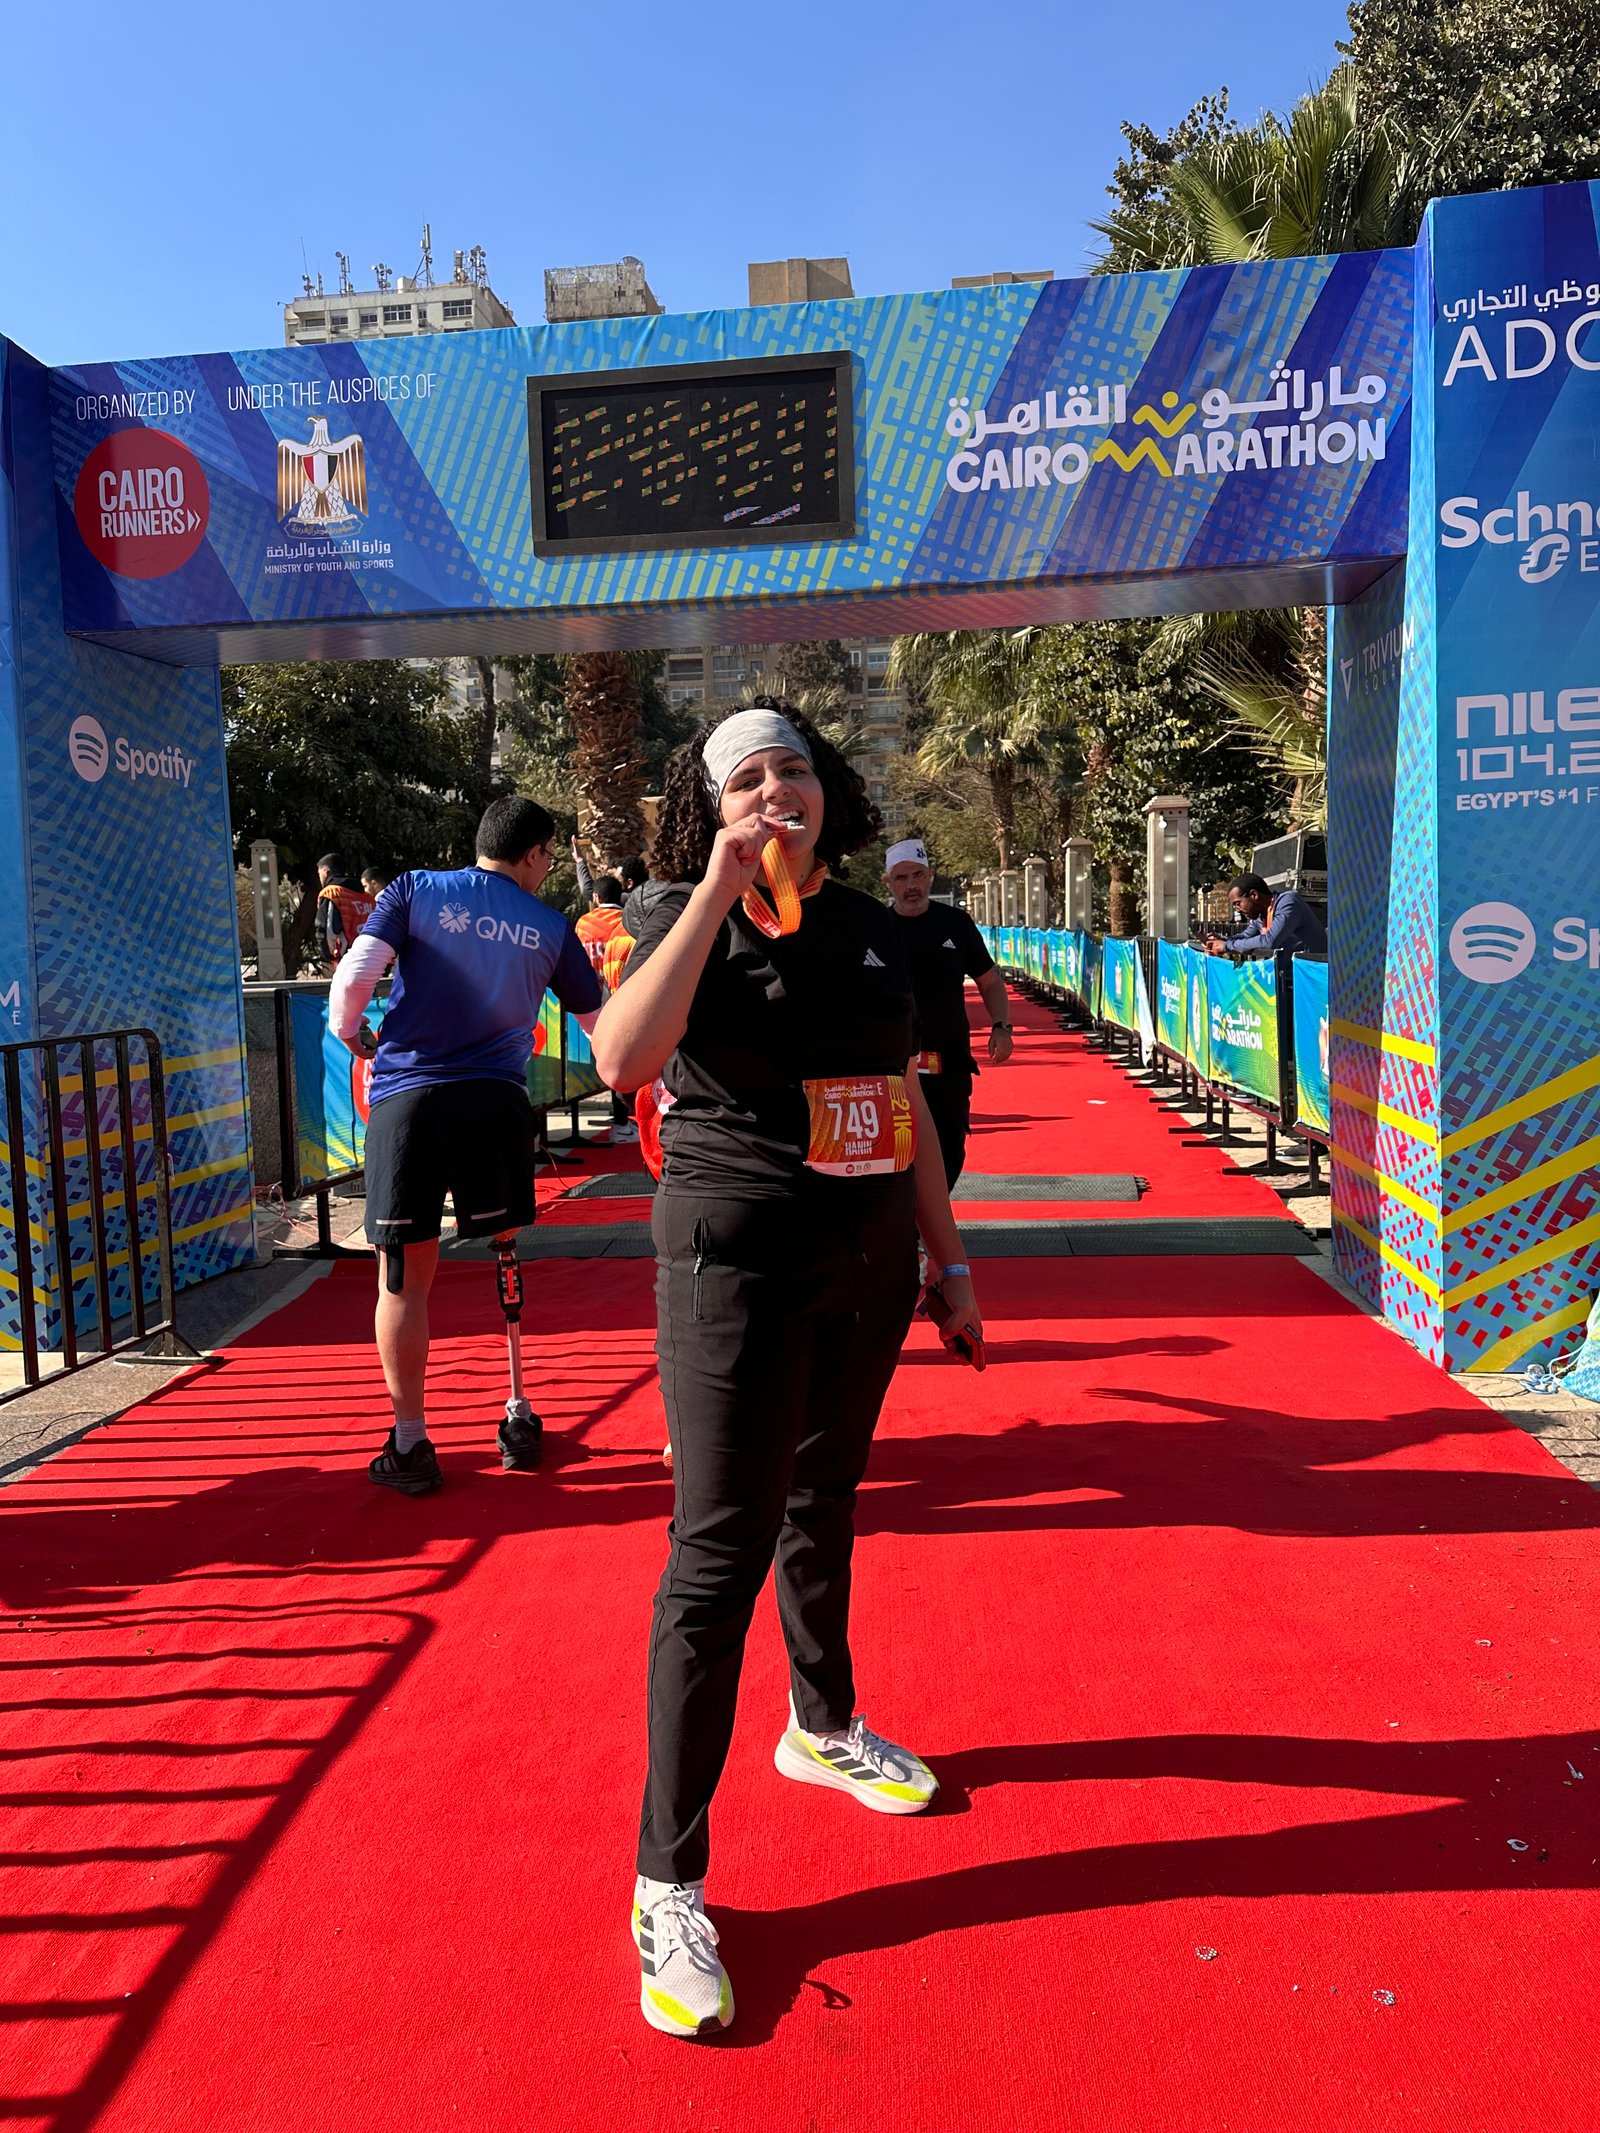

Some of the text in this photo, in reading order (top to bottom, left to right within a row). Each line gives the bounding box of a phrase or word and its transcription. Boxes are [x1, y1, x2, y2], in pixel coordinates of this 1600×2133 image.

[1442, 284, 1527, 323] التجاري
[75, 389, 196, 421] ORGANIZED BY
[227, 373, 437, 411] UNDER THE AUSPICES OF
[945, 384, 1126, 448] القاهرة
[945, 442, 1089, 494] CAIRO
[98, 466, 185, 512] CAIRO
[100, 508, 186, 539] RUNNERS
[1440, 490, 1600, 549] Schn
[264, 559, 394, 575] MINISTRY OF YOUTH AND SPORTS
[266, 539, 392, 559] وزارة الشباب والرياضة
[1362, 615, 1415, 676] TRIVIUM
[115, 737, 193, 788] Spotify
[1456, 789, 1555, 812] EGYPT'S
[1558, 787, 1579, 805] #1
[475, 915, 541, 950] QNB
[826, 1100, 880, 1141] 749
[891, 1098, 913, 1136] 21K
[845, 1141, 873, 1156] HANIN
